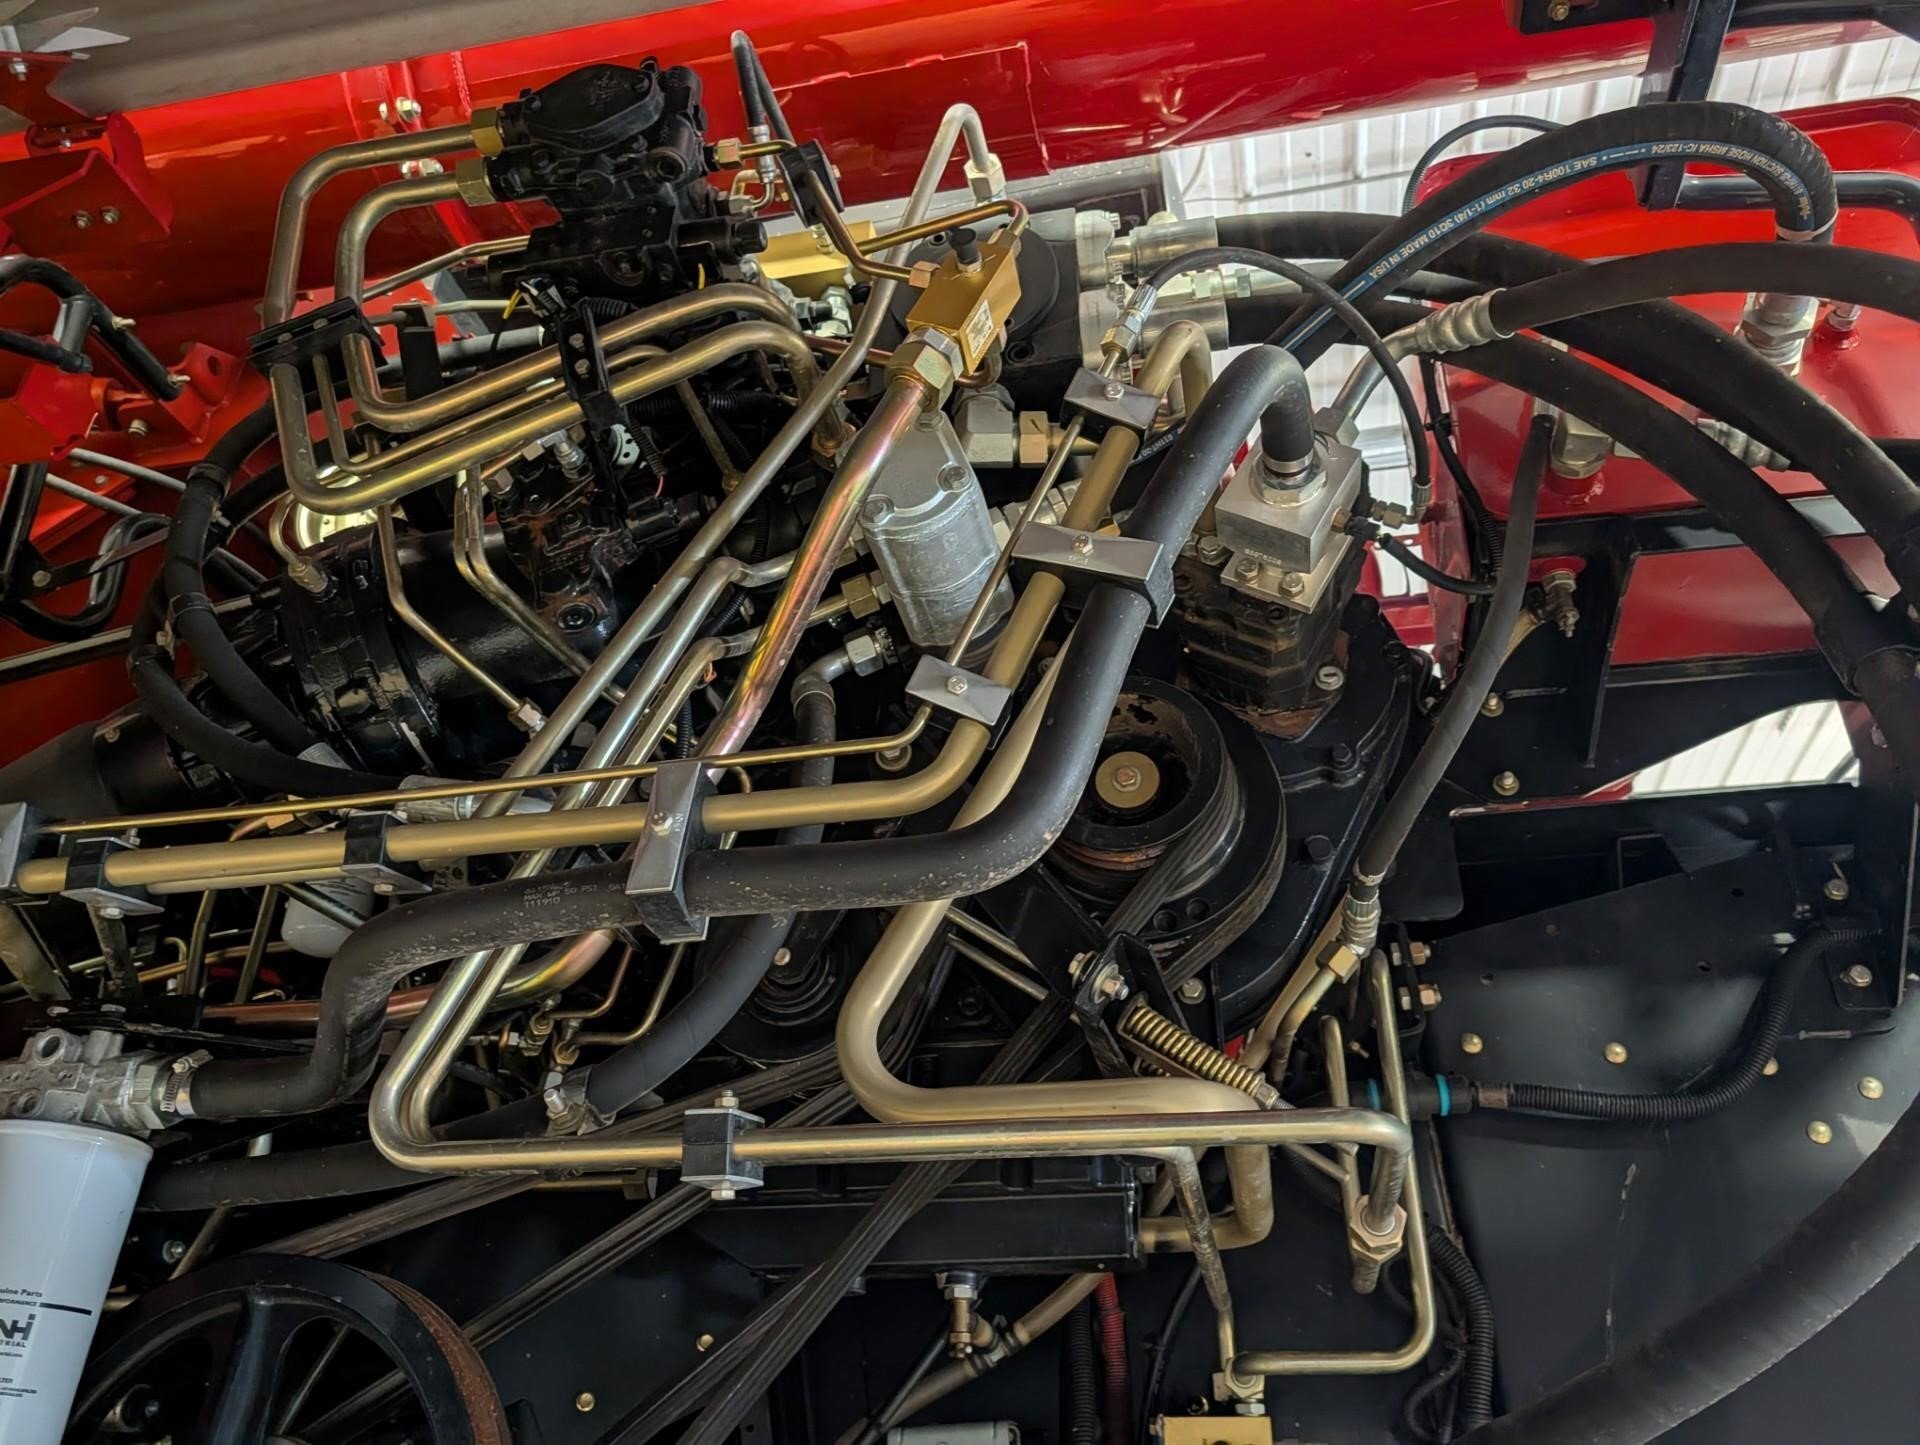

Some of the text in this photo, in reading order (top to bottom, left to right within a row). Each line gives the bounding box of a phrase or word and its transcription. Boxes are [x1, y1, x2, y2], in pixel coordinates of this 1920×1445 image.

[1699, 143, 1728, 156] MSHA
[1726, 147, 1754, 162] HOSE
[1573, 156, 1598, 171] SAE
[1522, 164, 1571, 189] 100R4-20
[1507, 183, 1521, 196] 32
[1485, 191, 1506, 205] mm
[1454, 201, 1486, 224] (1-1/4)
[1399, 233, 1430, 258] MADE
[1388, 254, 1401, 265] IN
[1368, 262, 1391, 279] USA
[20, 1288, 43, 1298] Parts
